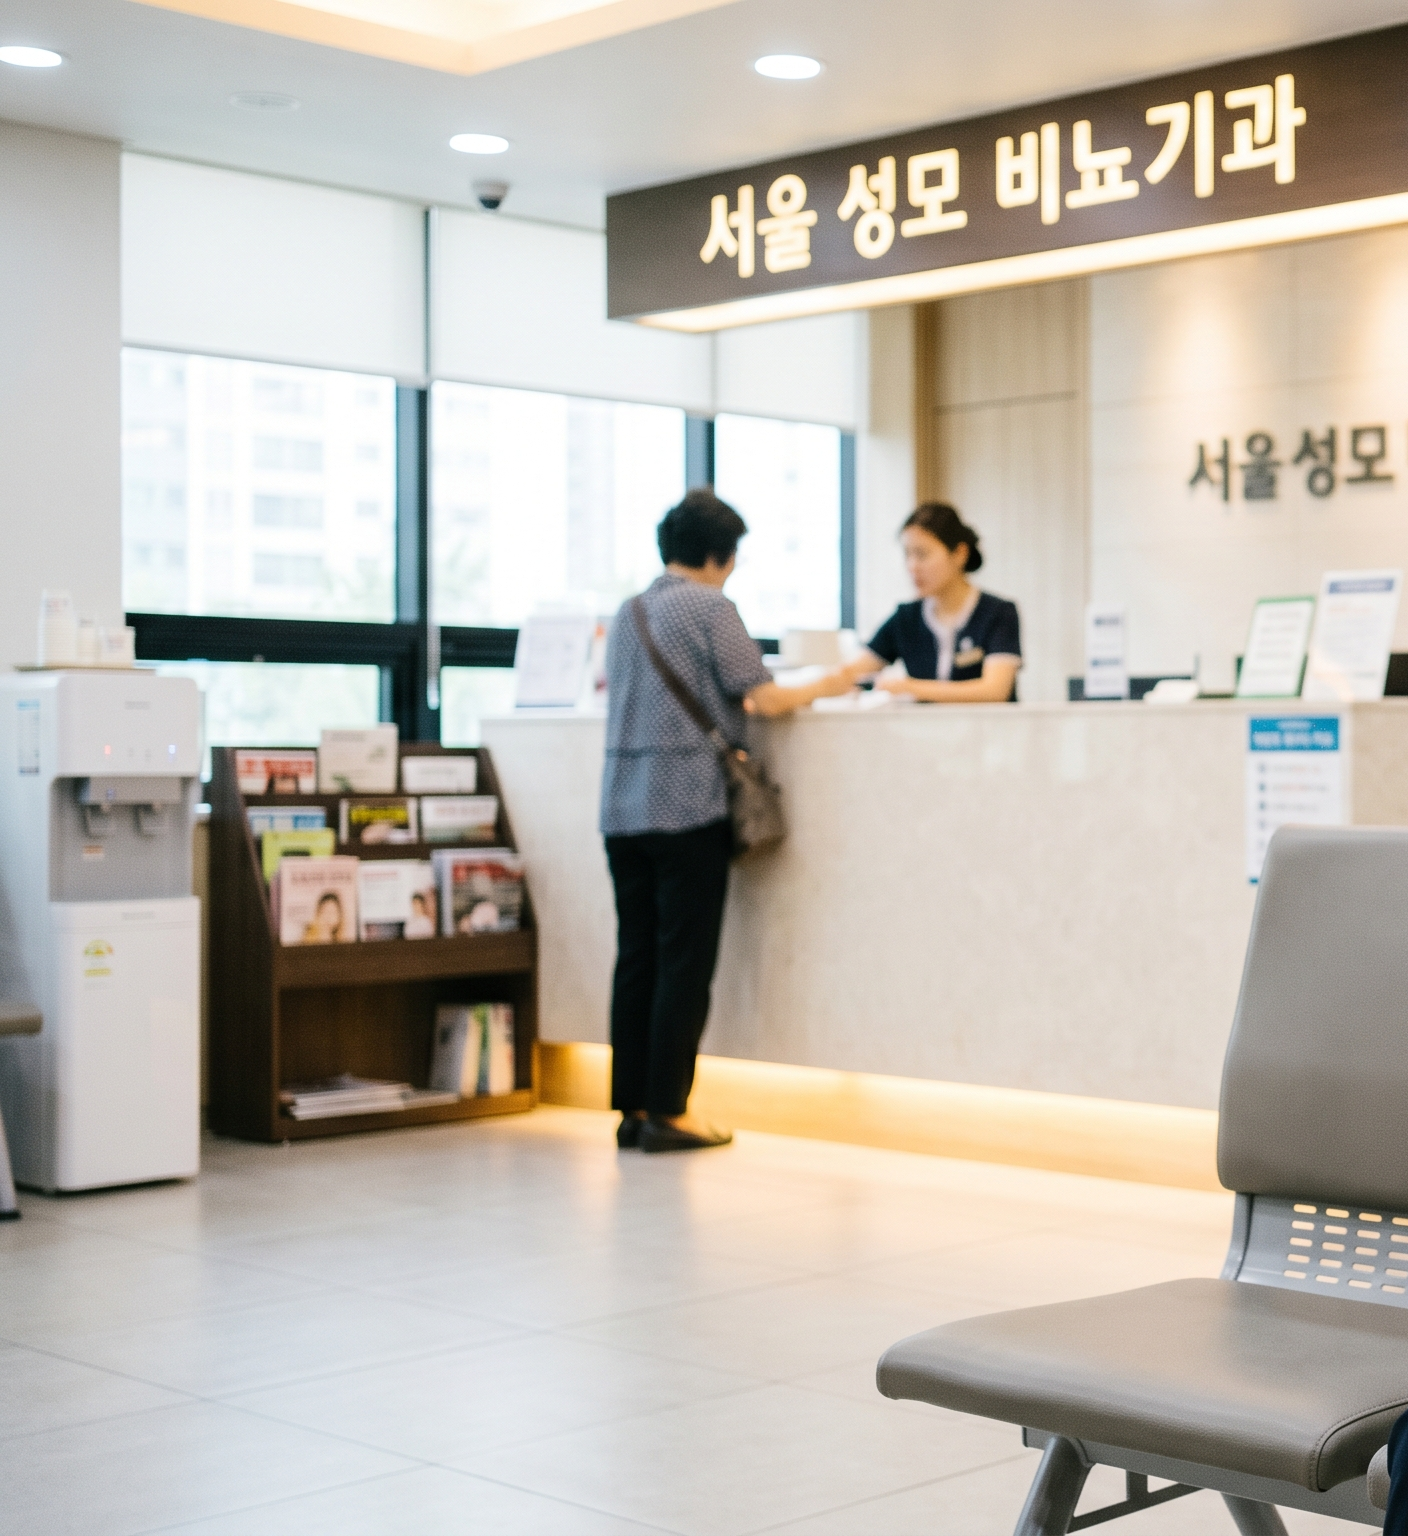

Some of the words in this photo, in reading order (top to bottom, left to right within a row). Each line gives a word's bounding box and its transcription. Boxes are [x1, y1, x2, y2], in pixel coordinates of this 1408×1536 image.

[699, 173, 818, 279] 서울
[836, 147, 969, 261] 성모
[993, 72, 1308, 226] 비뇨기과
[1189, 431, 1282, 502] 서울
[1292, 425, 1395, 499] 성모
